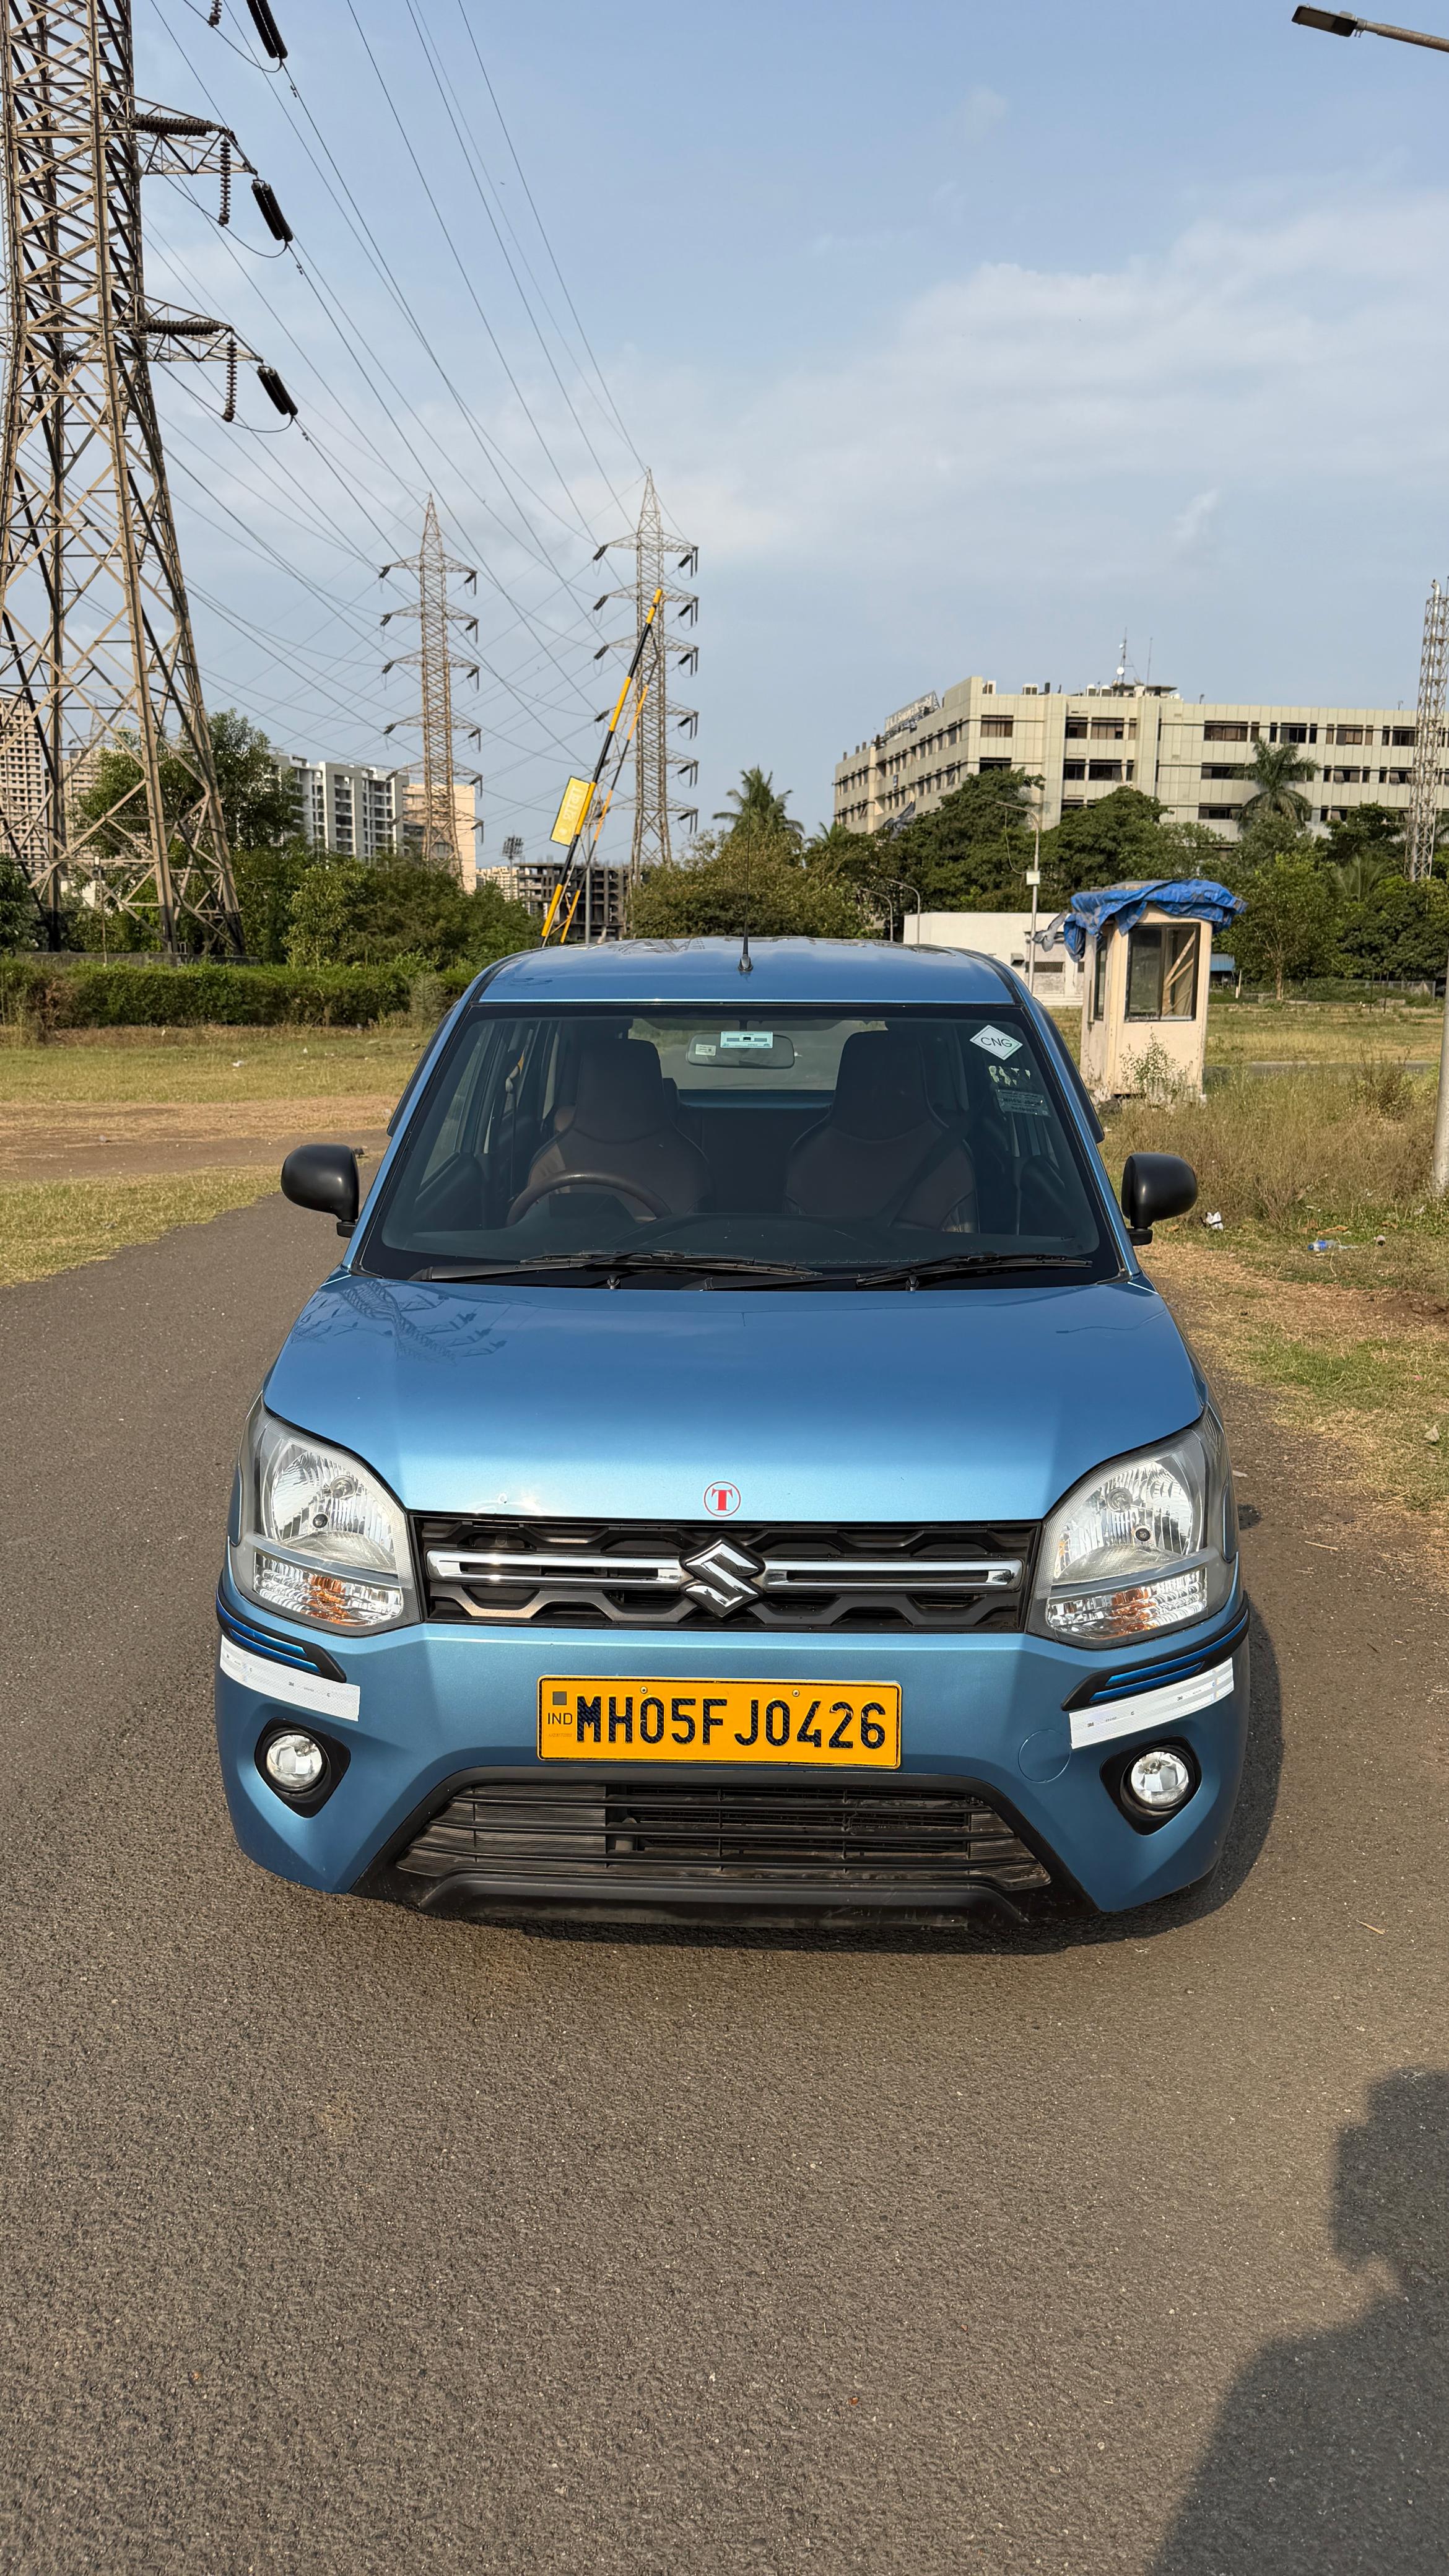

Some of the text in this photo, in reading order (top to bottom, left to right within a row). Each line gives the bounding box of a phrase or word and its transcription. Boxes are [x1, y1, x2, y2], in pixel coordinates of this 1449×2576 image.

[980, 1037, 1012, 1048] CNG
[711, 1488, 733, 1511] T
[547, 1713, 573, 1725] IND
[576, 1695, 886, 1749] MH05FJ0426
